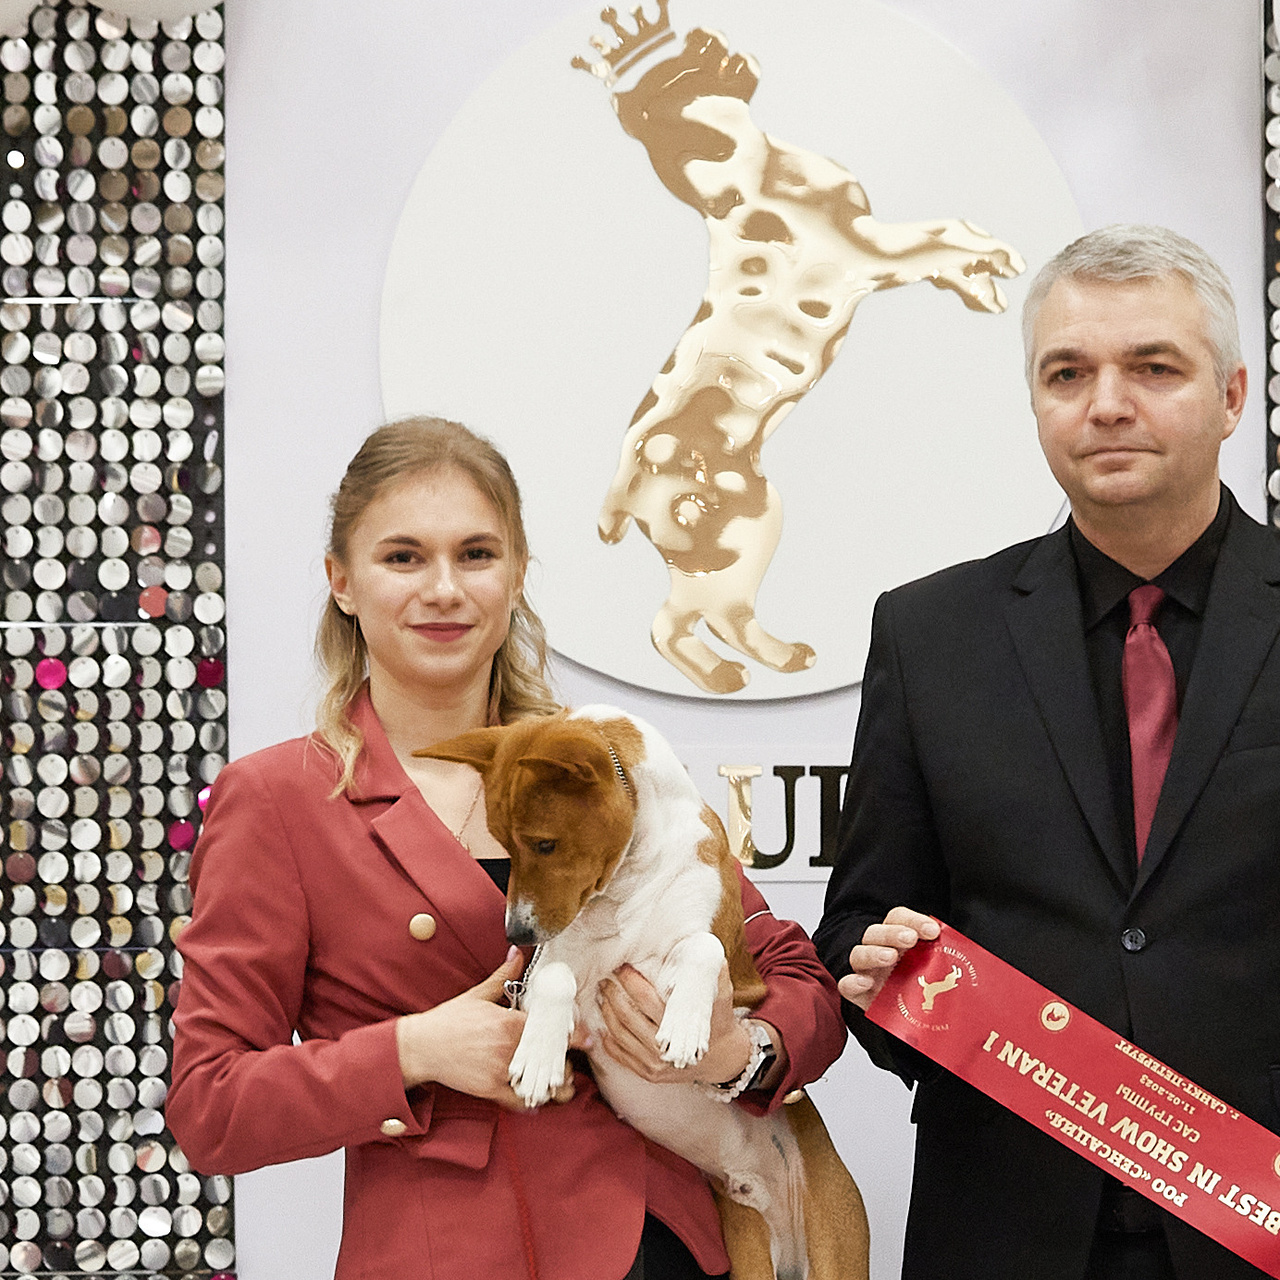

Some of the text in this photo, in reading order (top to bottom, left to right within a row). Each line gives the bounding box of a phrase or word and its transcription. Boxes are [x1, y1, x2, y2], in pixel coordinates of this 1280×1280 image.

[996, 1039, 1110, 1127] VETERAN
[1113, 1038, 1228, 1116] САНКТ-ПЕТЕРБУРГ
[1114, 1082, 1174, 1127] ГРУППЫ
[1139, 1073, 1197, 1116] 11.02.2023
[1043, 1109, 1189, 1208] РОО «СЕНСАЦИЯ»
[1109, 1116, 1191, 1174] SHOW
[1185, 1161, 1224, 1195] IN
